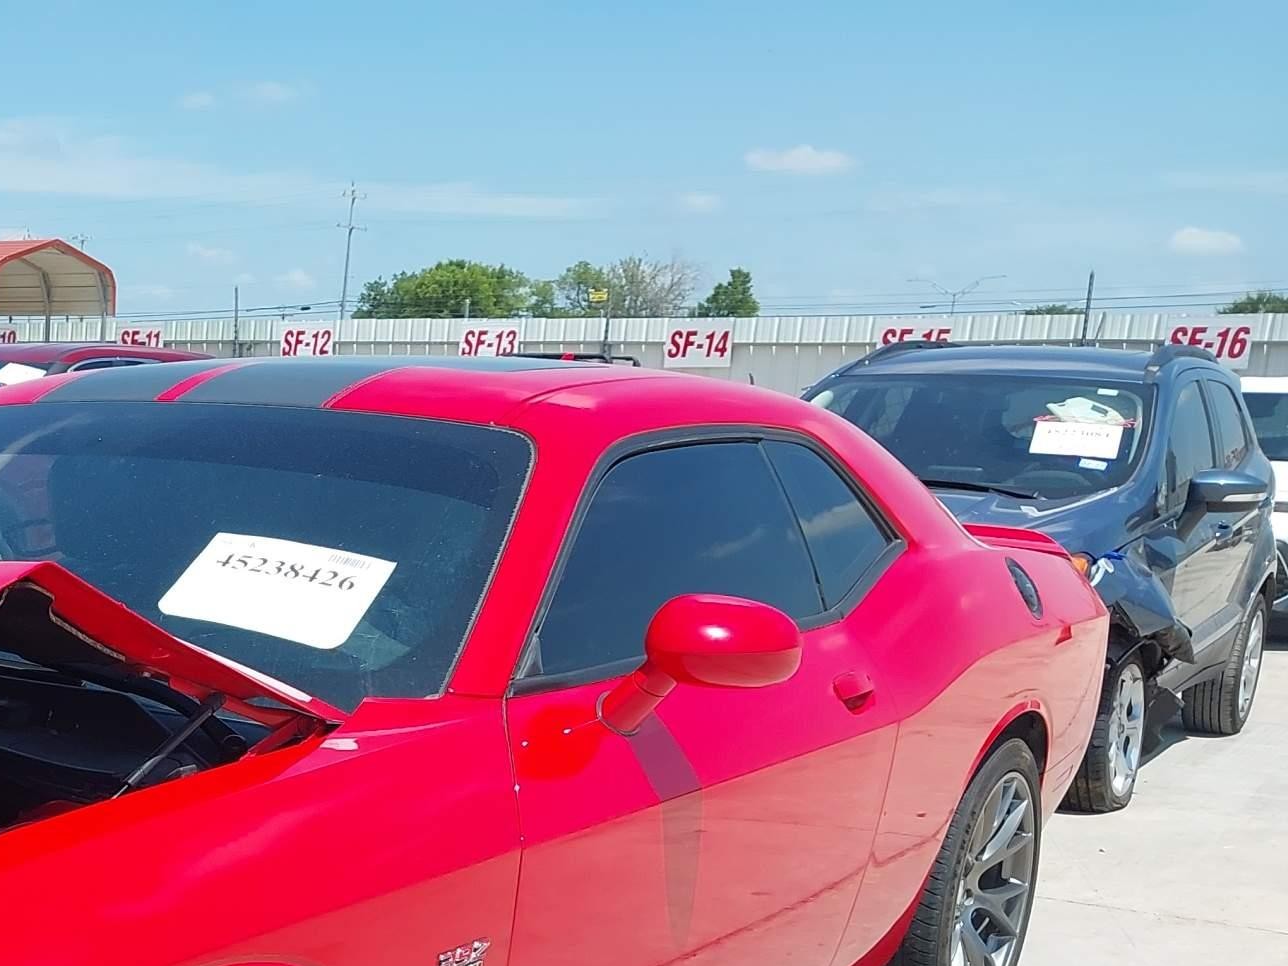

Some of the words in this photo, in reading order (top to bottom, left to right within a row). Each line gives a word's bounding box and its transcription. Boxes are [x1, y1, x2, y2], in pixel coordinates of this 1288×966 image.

[121, 330, 161, 348] SF-11
[282, 329, 331, 356] SF-12
[461, 329, 518, 356] SF-13
[667, 330, 730, 358] SF-14
[1170, 326, 1251, 359] SF-16
[216, 552, 356, 591] 45238426
